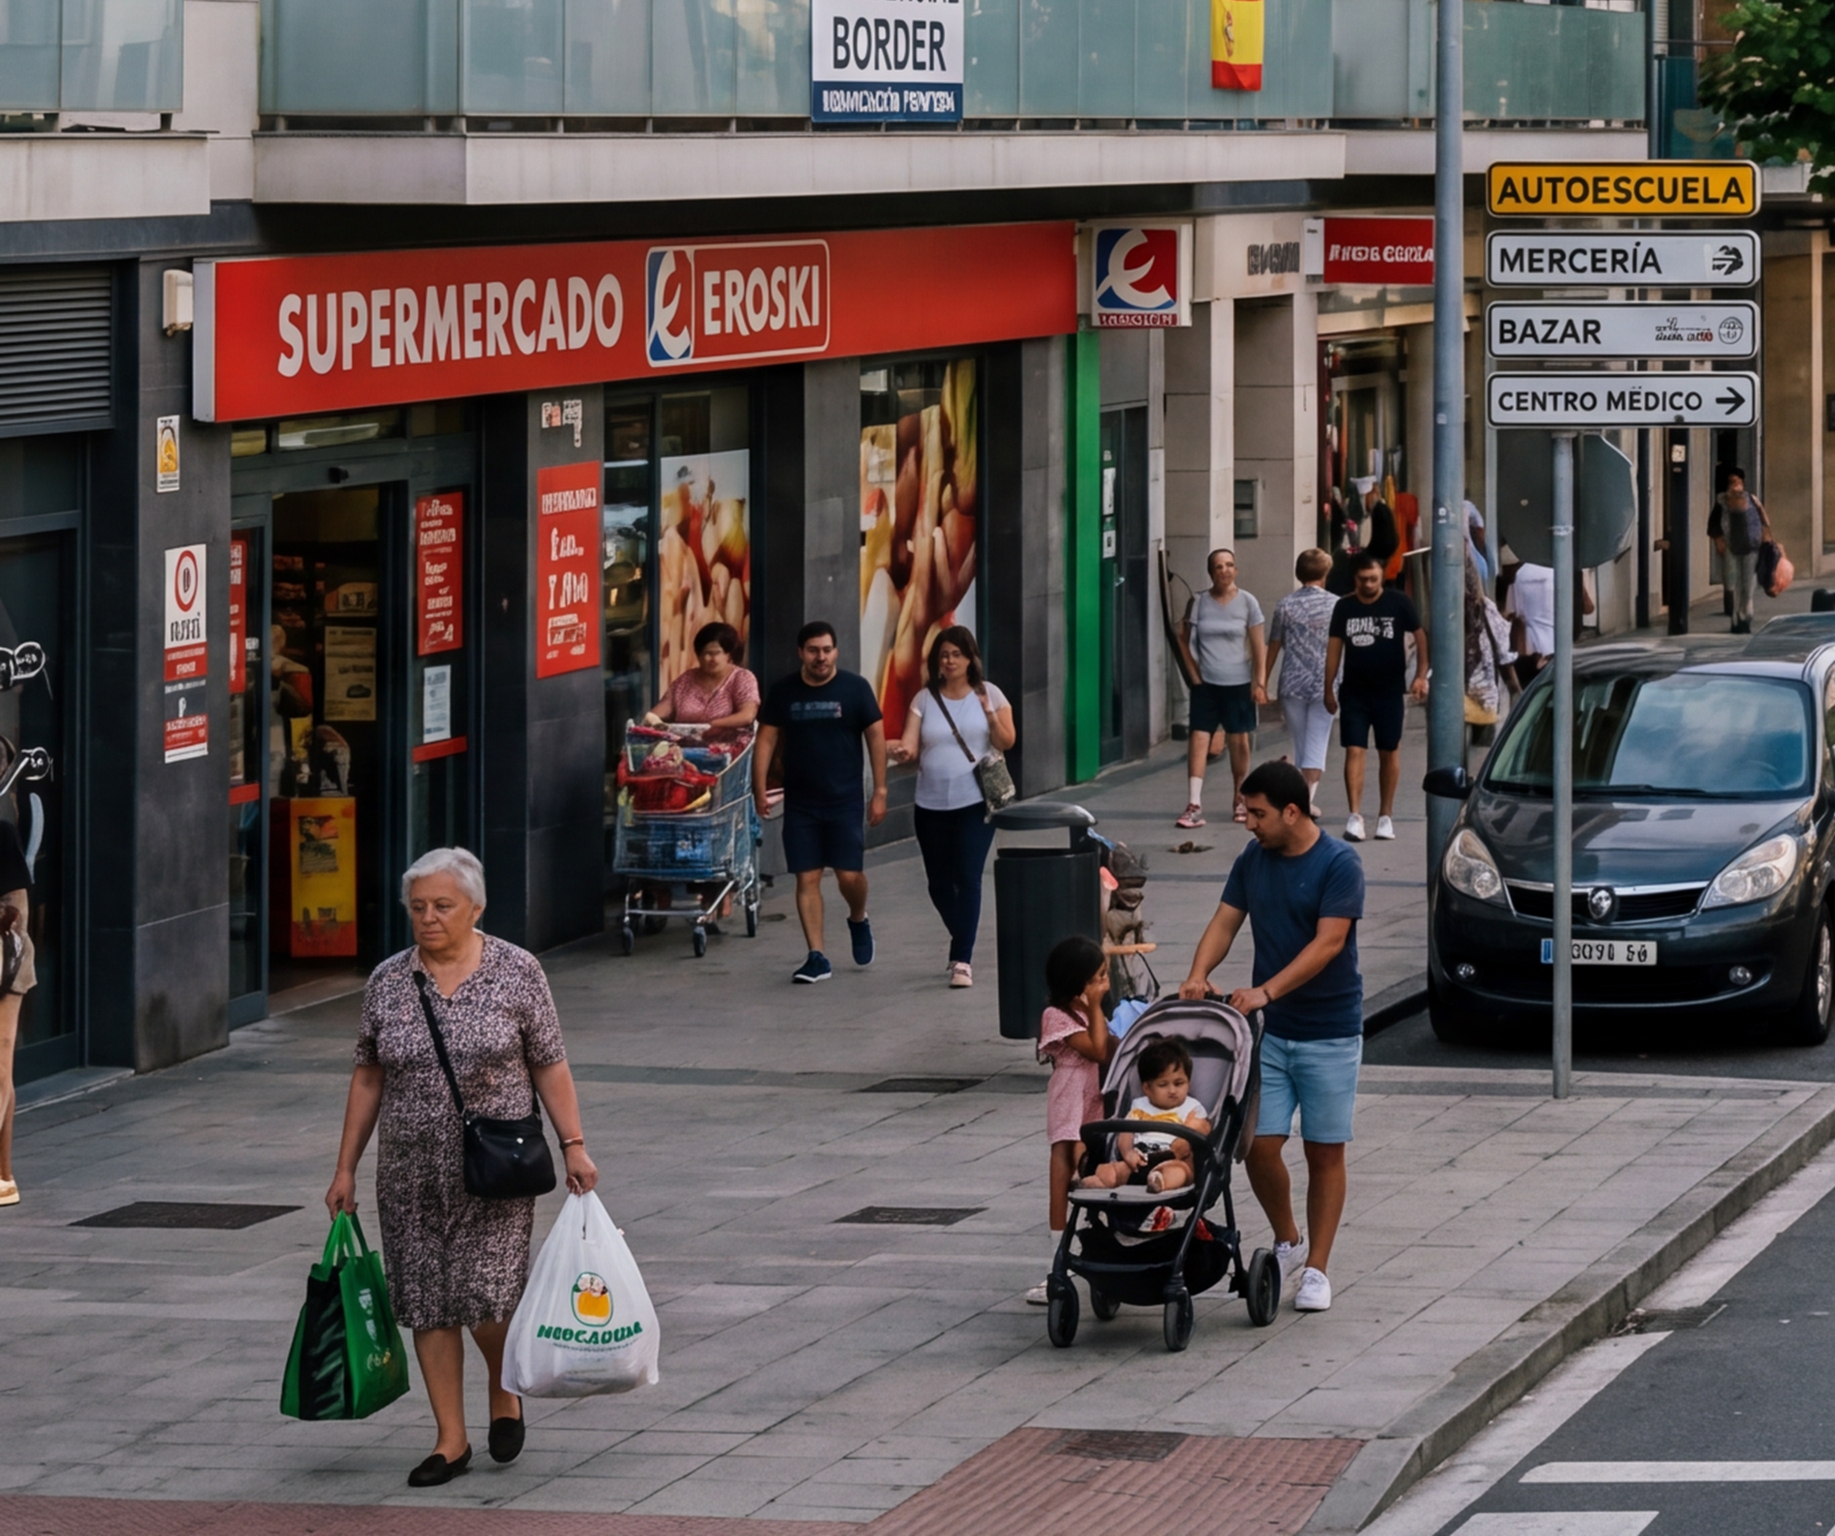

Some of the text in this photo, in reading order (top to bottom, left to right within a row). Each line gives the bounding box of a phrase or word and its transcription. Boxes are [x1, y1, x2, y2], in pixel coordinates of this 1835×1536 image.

[833, 16, 946, 71] BORDER
[1497, 176, 1746, 205] AUTOESCUELA
[1499, 241, 1663, 275] MERCERÍA
[277, 264, 821, 378] SUPERMERCADO EROSKI
[1499, 319, 1602, 345] BAZAR
[1498, 391, 1598, 413] CENTRO
